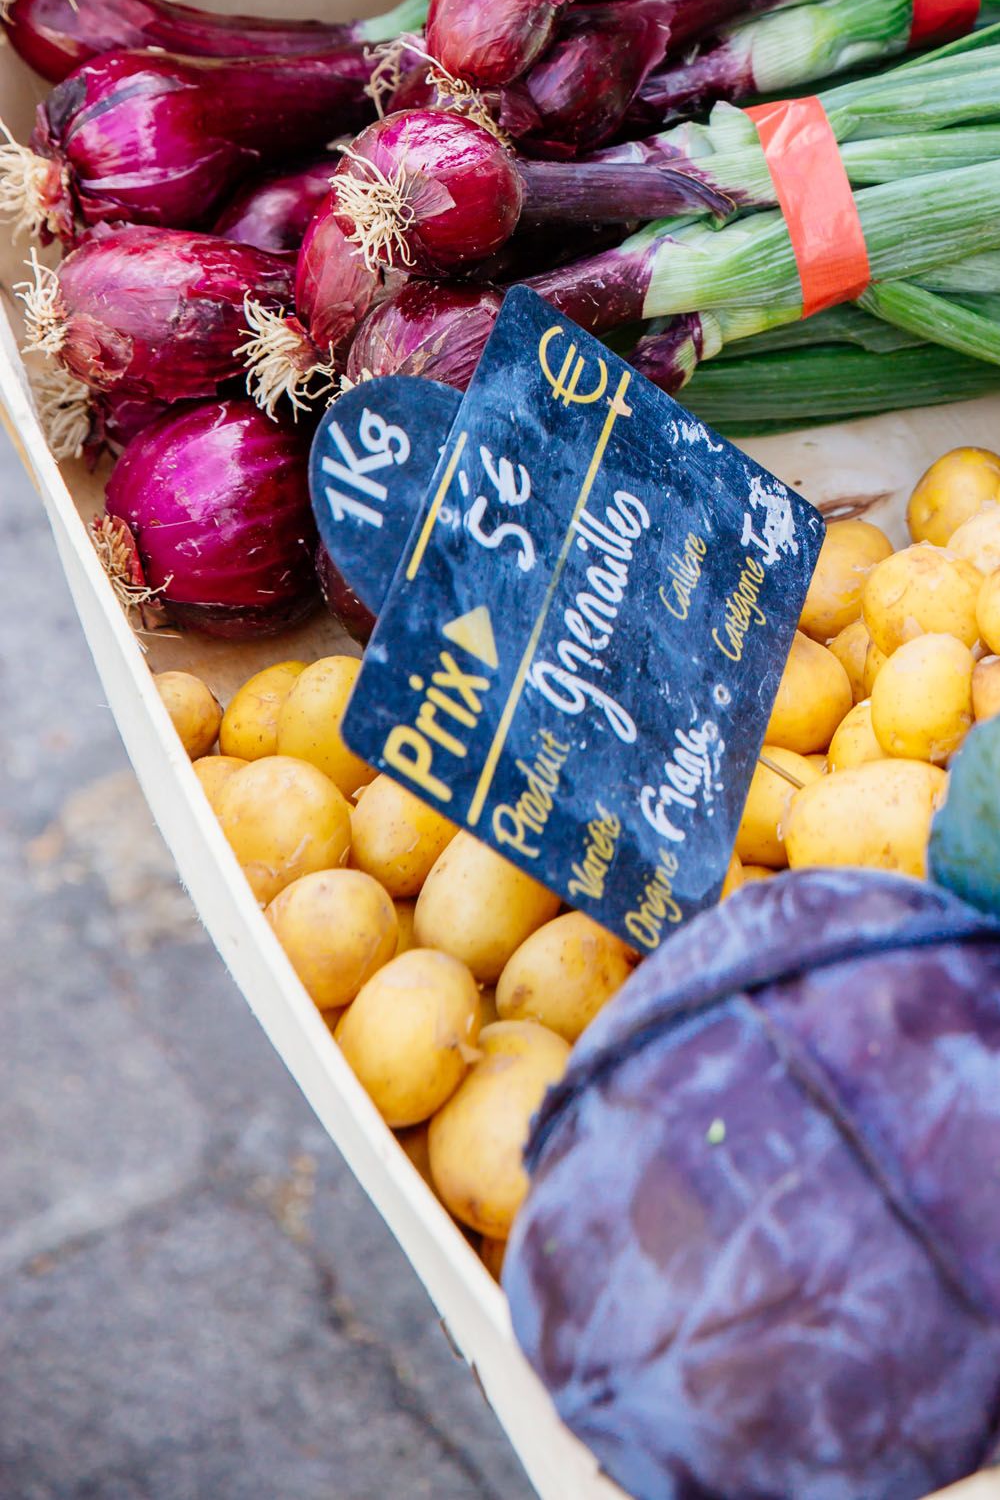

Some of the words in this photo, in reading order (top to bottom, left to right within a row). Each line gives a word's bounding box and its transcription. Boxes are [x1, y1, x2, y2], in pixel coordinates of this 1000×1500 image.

[538, 324, 608, 407] €
[321, 407, 411, 528] 1Kg
[658, 531, 708, 621] Calibre
[382, 647, 491, 802] Prix
[492, 728, 571, 860] Produit
